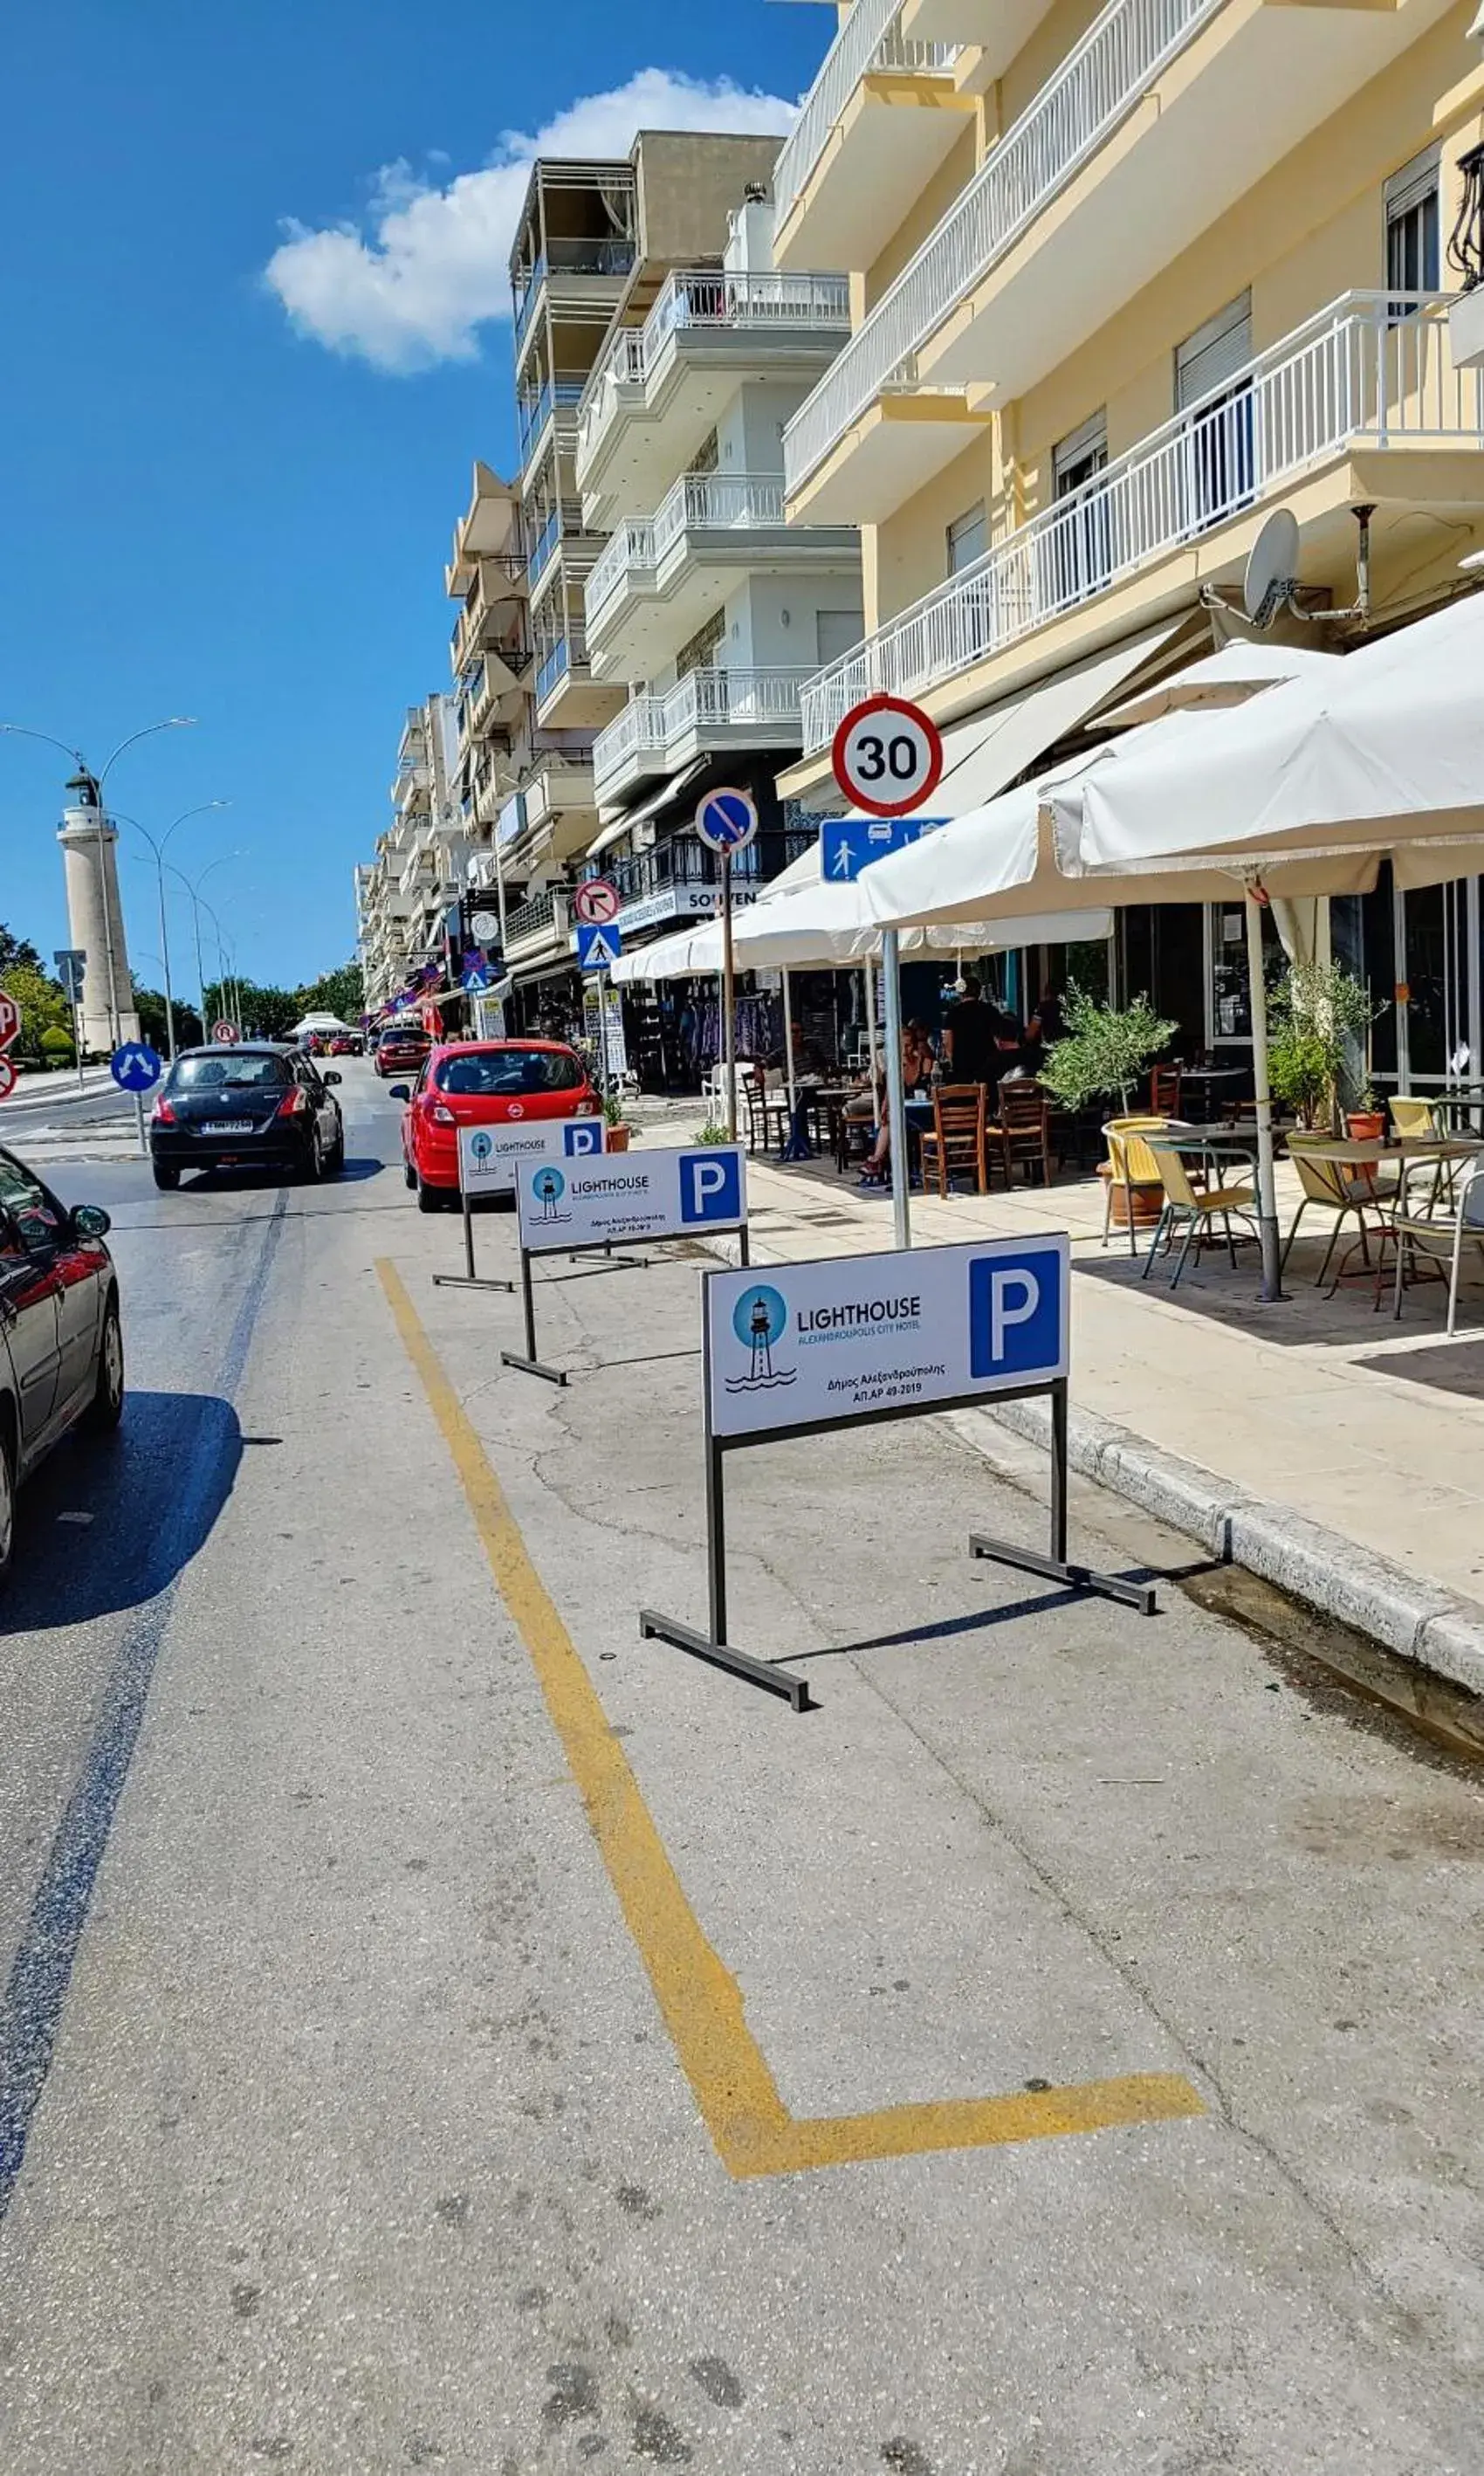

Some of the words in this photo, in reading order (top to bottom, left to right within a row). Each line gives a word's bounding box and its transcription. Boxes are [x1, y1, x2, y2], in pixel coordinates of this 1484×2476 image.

[857, 735, 917, 781] 30
[496, 1139, 546, 1153] LIGHTHOUSE
[573, 1129, 594, 1156] P
[572, 1175, 649, 1194] LIGHTHOUSE
[692, 1161, 726, 1214] P
[797, 1296, 921, 1332] LIGHTHOUSE
[992, 1269, 1040, 1361] P
[798, 1326, 875, 1345] ALEXANDROUPOLIS
[876, 1322, 894, 1335] CITY
[896, 1319, 921, 1331] HOTEL
[828, 1379, 859, 1392] Δήμος
